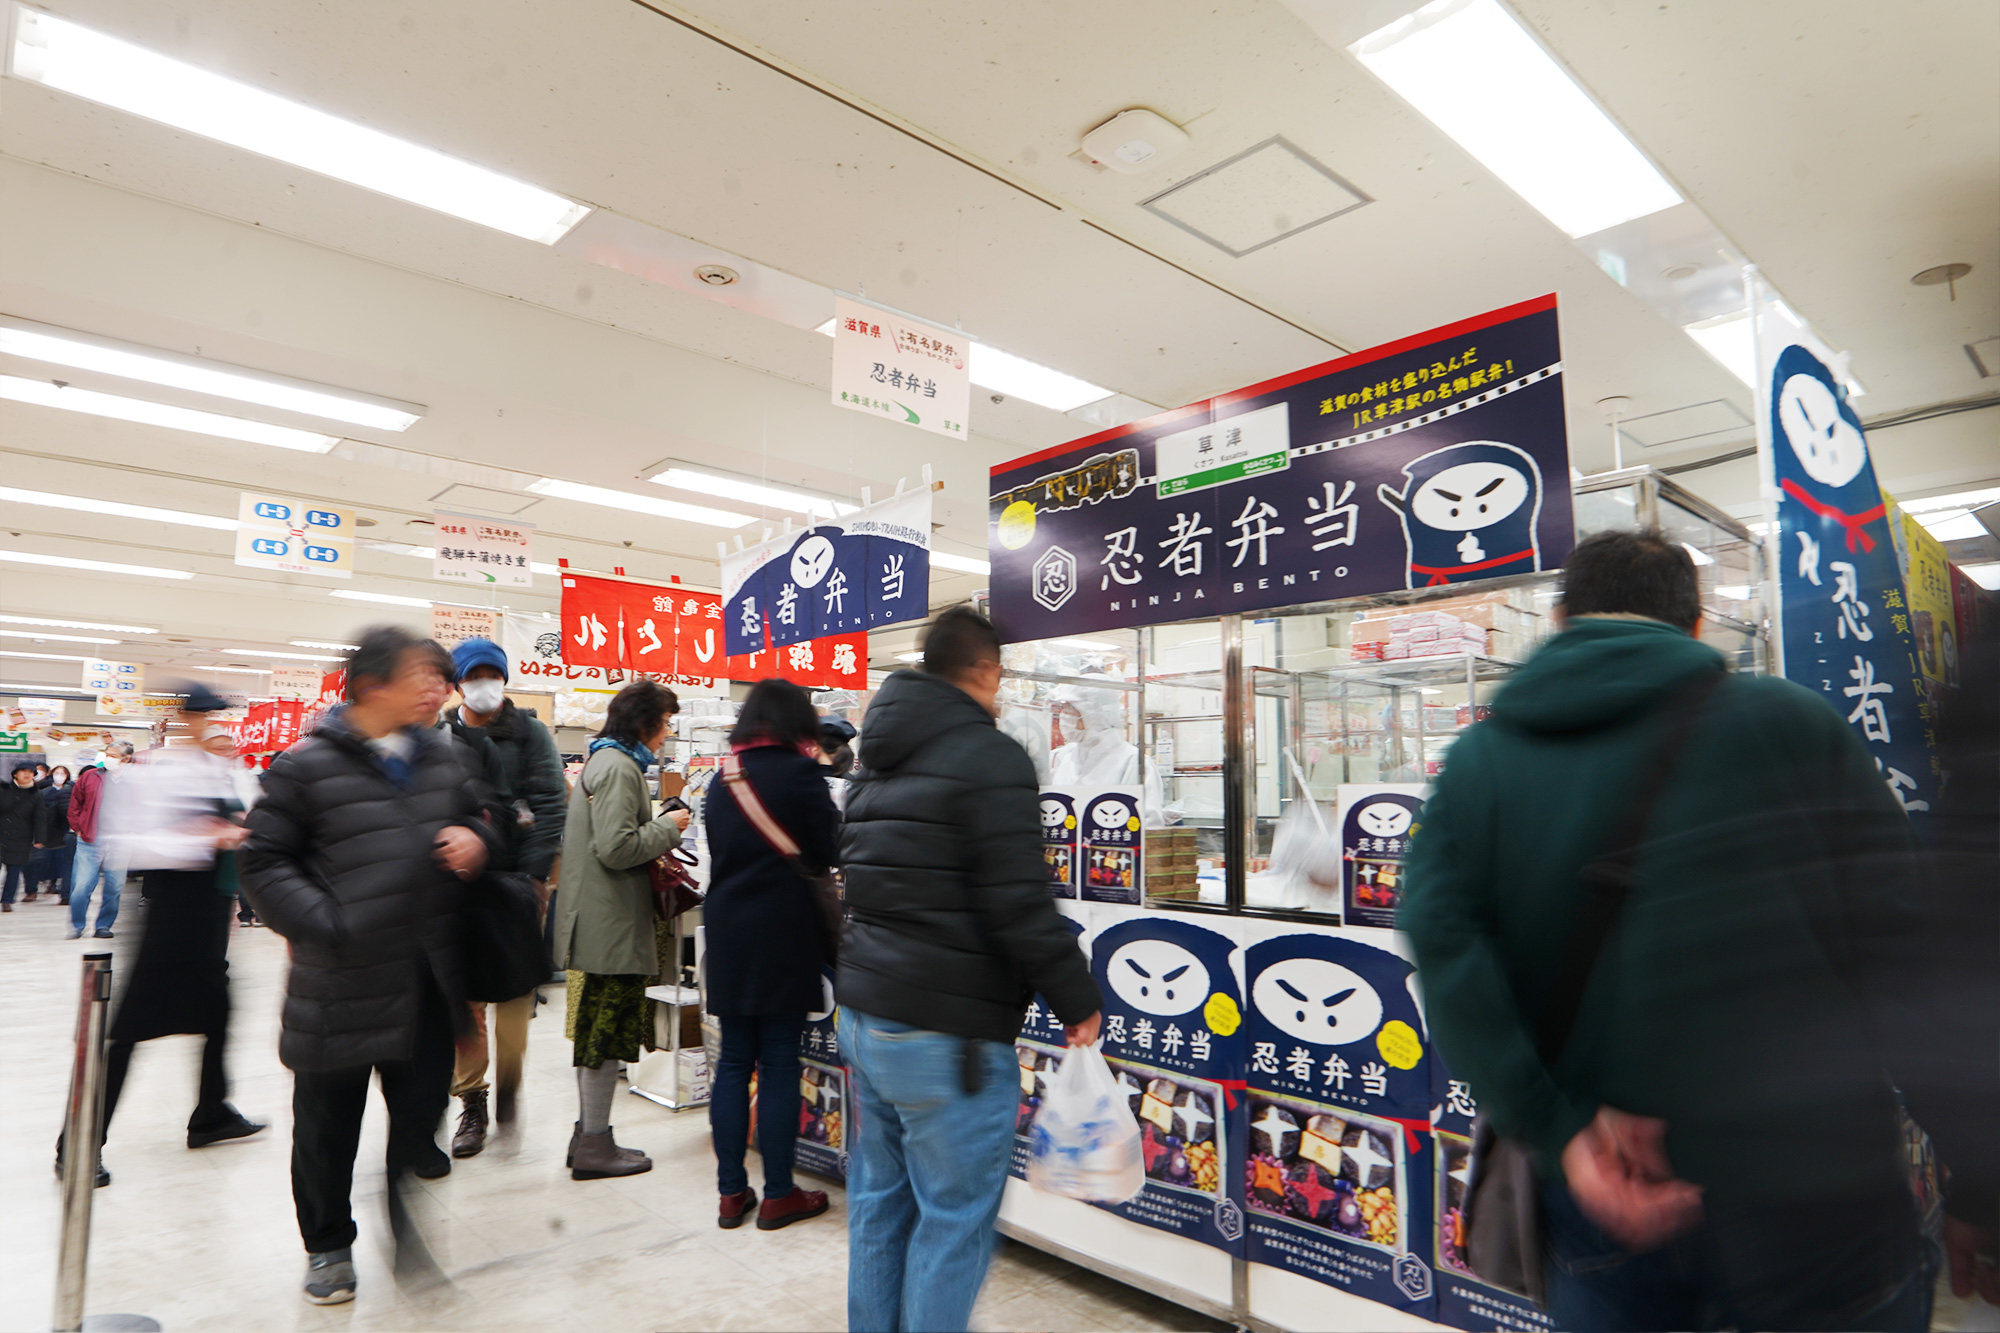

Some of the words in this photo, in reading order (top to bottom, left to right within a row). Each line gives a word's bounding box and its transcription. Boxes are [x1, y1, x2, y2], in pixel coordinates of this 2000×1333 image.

[844, 317, 882, 339] 滋賀県
[870, 361, 938, 399] 忍者弁当
[1319, 346, 1479, 416] 滋賀の食材を盛り込んだ
[840, 391, 890, 413] 東海道本線
[1352, 359, 1515, 430] JR草津駅の名物駅弁!
[1198, 427, 1242, 454] 草津
[258, 503, 287, 519] A-5
[310, 511, 338, 527] B-5
[1100, 480, 1359, 591] 忍者弁当
[1043, 559, 1067, 596] 忍
[1110, 588, 1206, 612] NINJA
[1233, 566, 1349, 594] BENTO
[740, 555, 905, 636] 忍者弁当
[823, 610, 893, 630] BENTO
[520, 660, 601, 679] いわしの
[1091, 829, 1132, 842] 忍者弁当
[1106, 1014, 1212, 1061] 忍者弁当
[1120, 1048, 1155, 1060] NINJA
[1159, 1056, 1196, 1070] BENTO
[1252, 1041, 1388, 1097] 忍者弁当
[1270, 1079, 1314, 1094] NINJA
[1320, 1089, 1369, 1106] BENTO
[1221, 1207, 1237, 1231] 忍
[1402, 1263, 1425, 1290] 忍
